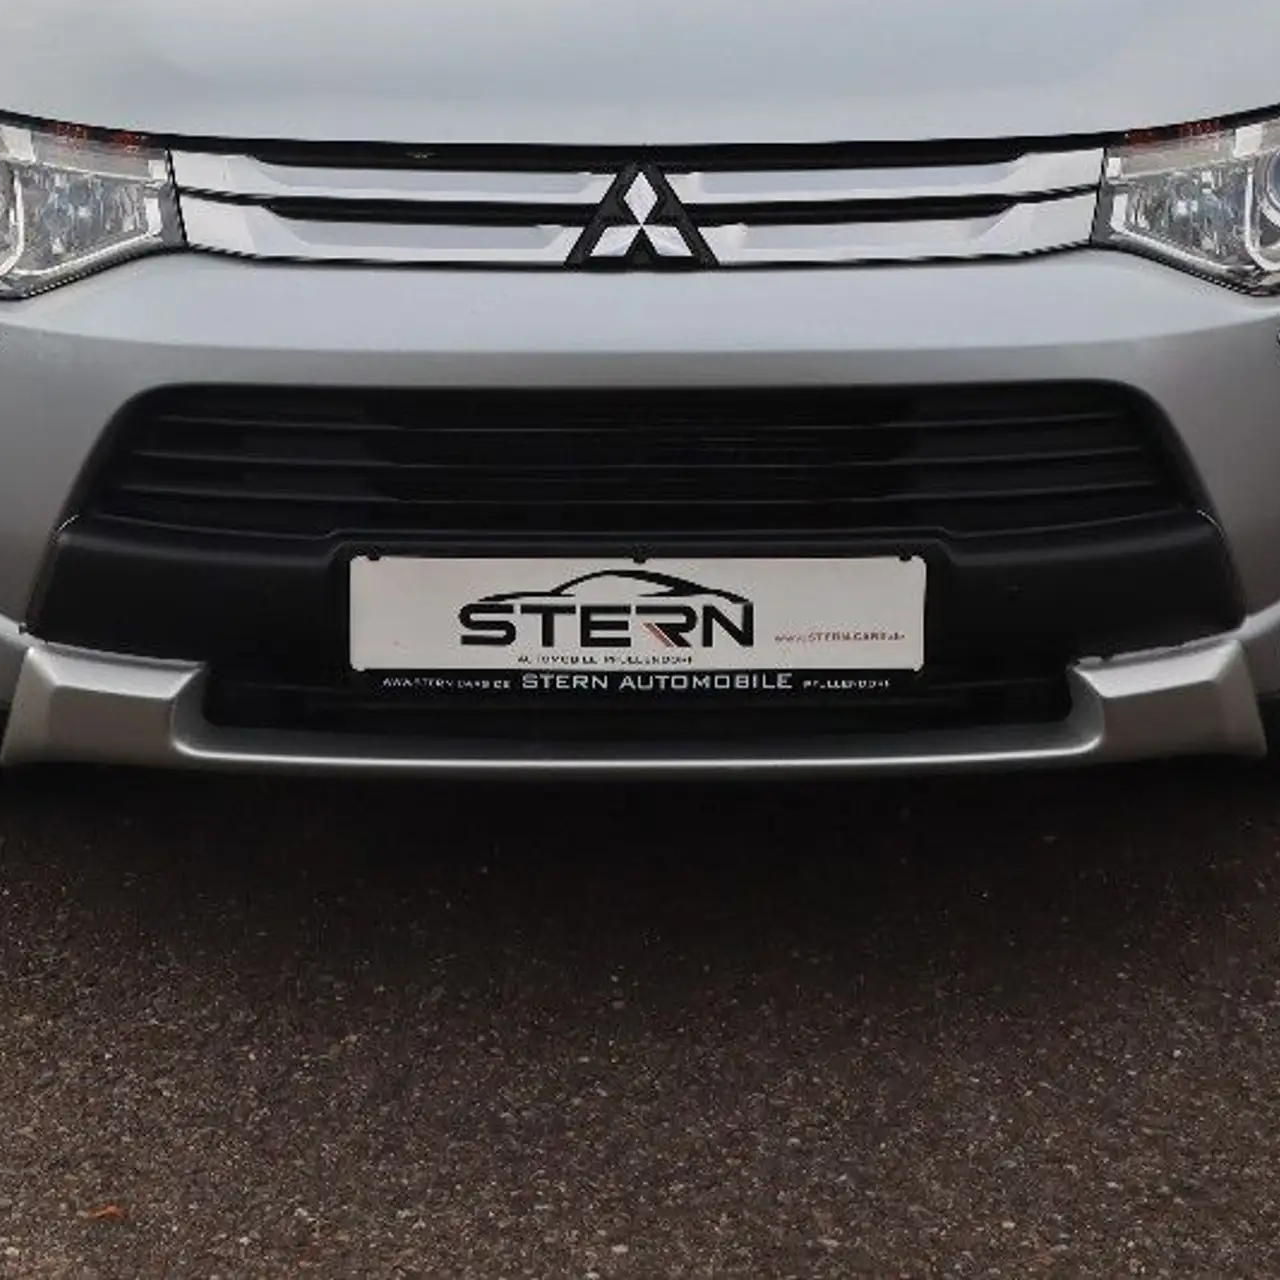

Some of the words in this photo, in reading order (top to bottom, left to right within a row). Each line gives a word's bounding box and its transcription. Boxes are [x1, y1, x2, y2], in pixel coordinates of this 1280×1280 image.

[458, 602, 754, 647] STERN
[522, 673, 609, 689] STERN
[619, 673, 793, 689] AUTOMOBILE
